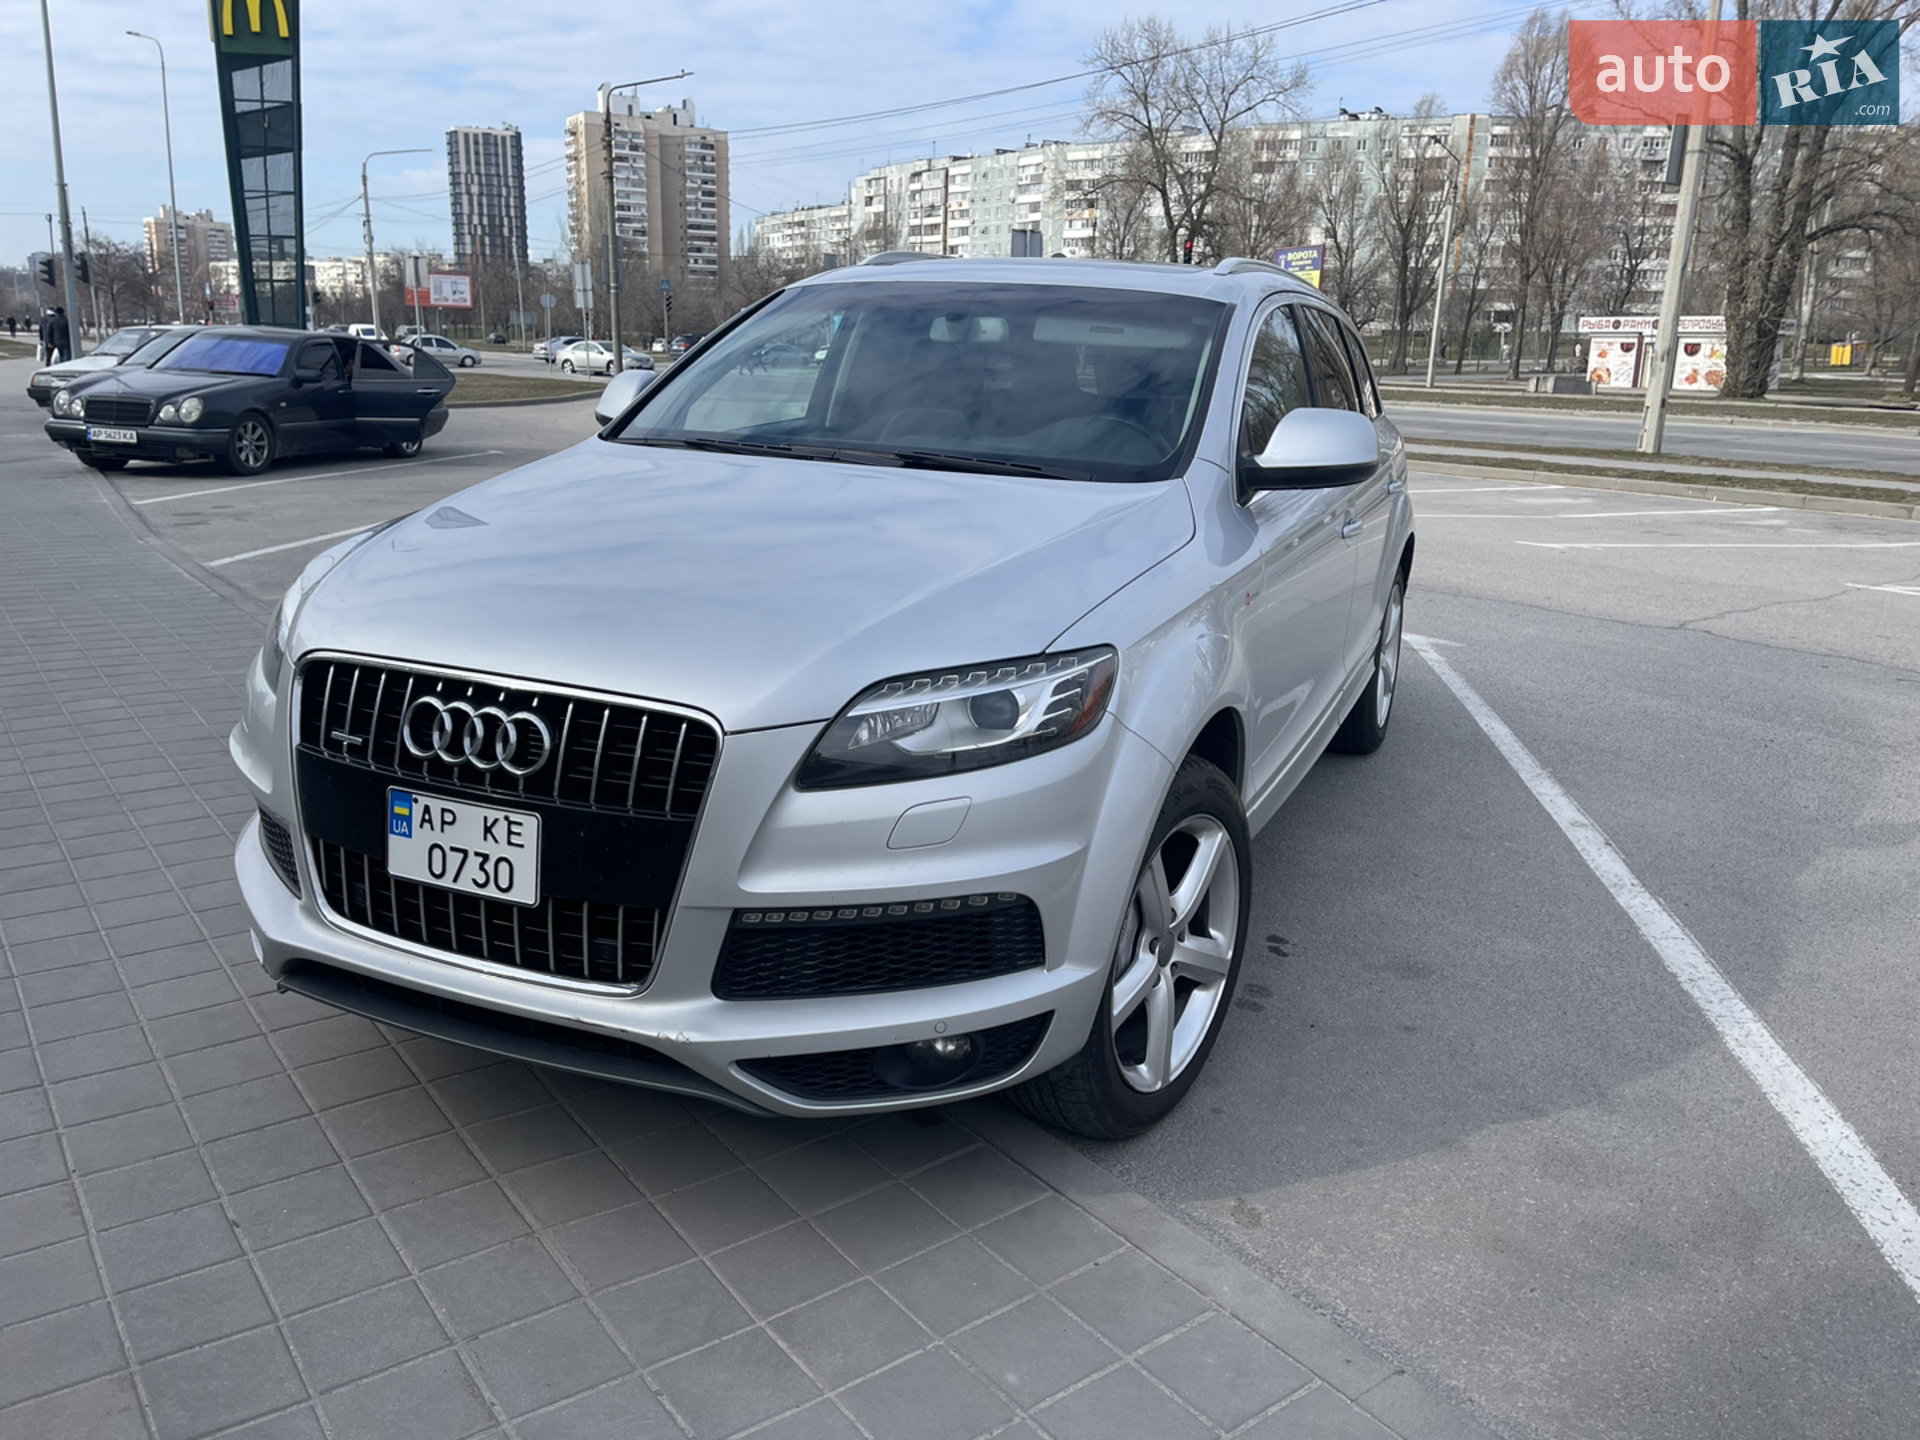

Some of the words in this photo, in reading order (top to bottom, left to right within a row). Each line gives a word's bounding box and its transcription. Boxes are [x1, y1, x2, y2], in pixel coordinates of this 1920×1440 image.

[1581, 319, 1611, 330] РЫБА
[392, 818, 410, 835] UA
[419, 803, 457, 834] AP
[483, 815, 525, 849] KE
[427, 842, 514, 894] 0730
